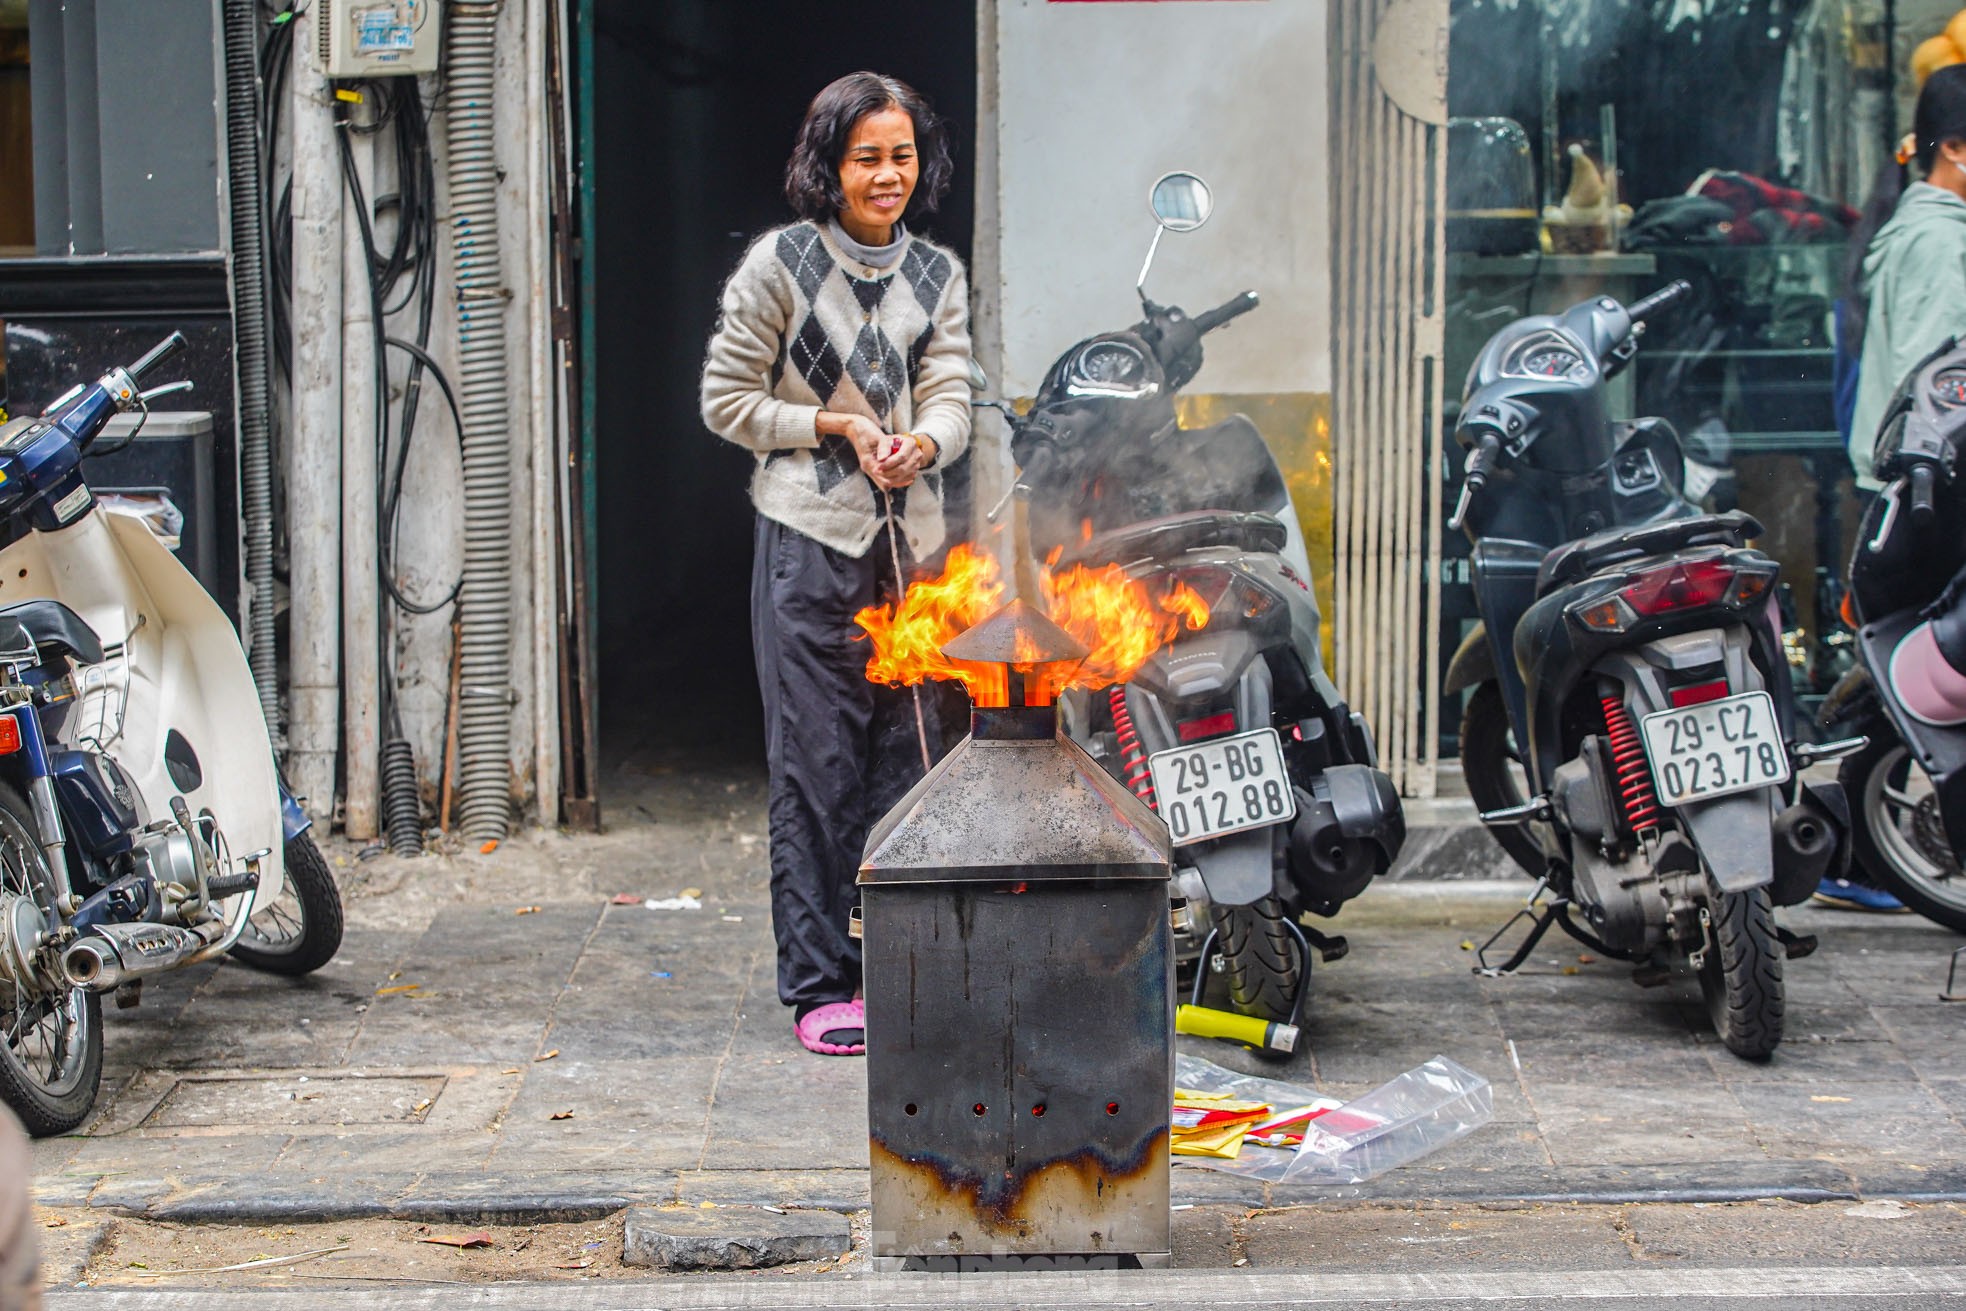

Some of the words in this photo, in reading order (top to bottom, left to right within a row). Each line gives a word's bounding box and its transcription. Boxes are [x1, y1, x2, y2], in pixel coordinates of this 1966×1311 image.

[1664, 704, 1758, 756] 29-C2
[1171, 741, 1263, 795] 29-BG
[1663, 742, 1778, 799] 023.78
[1170, 780, 1284, 838] 012.88
